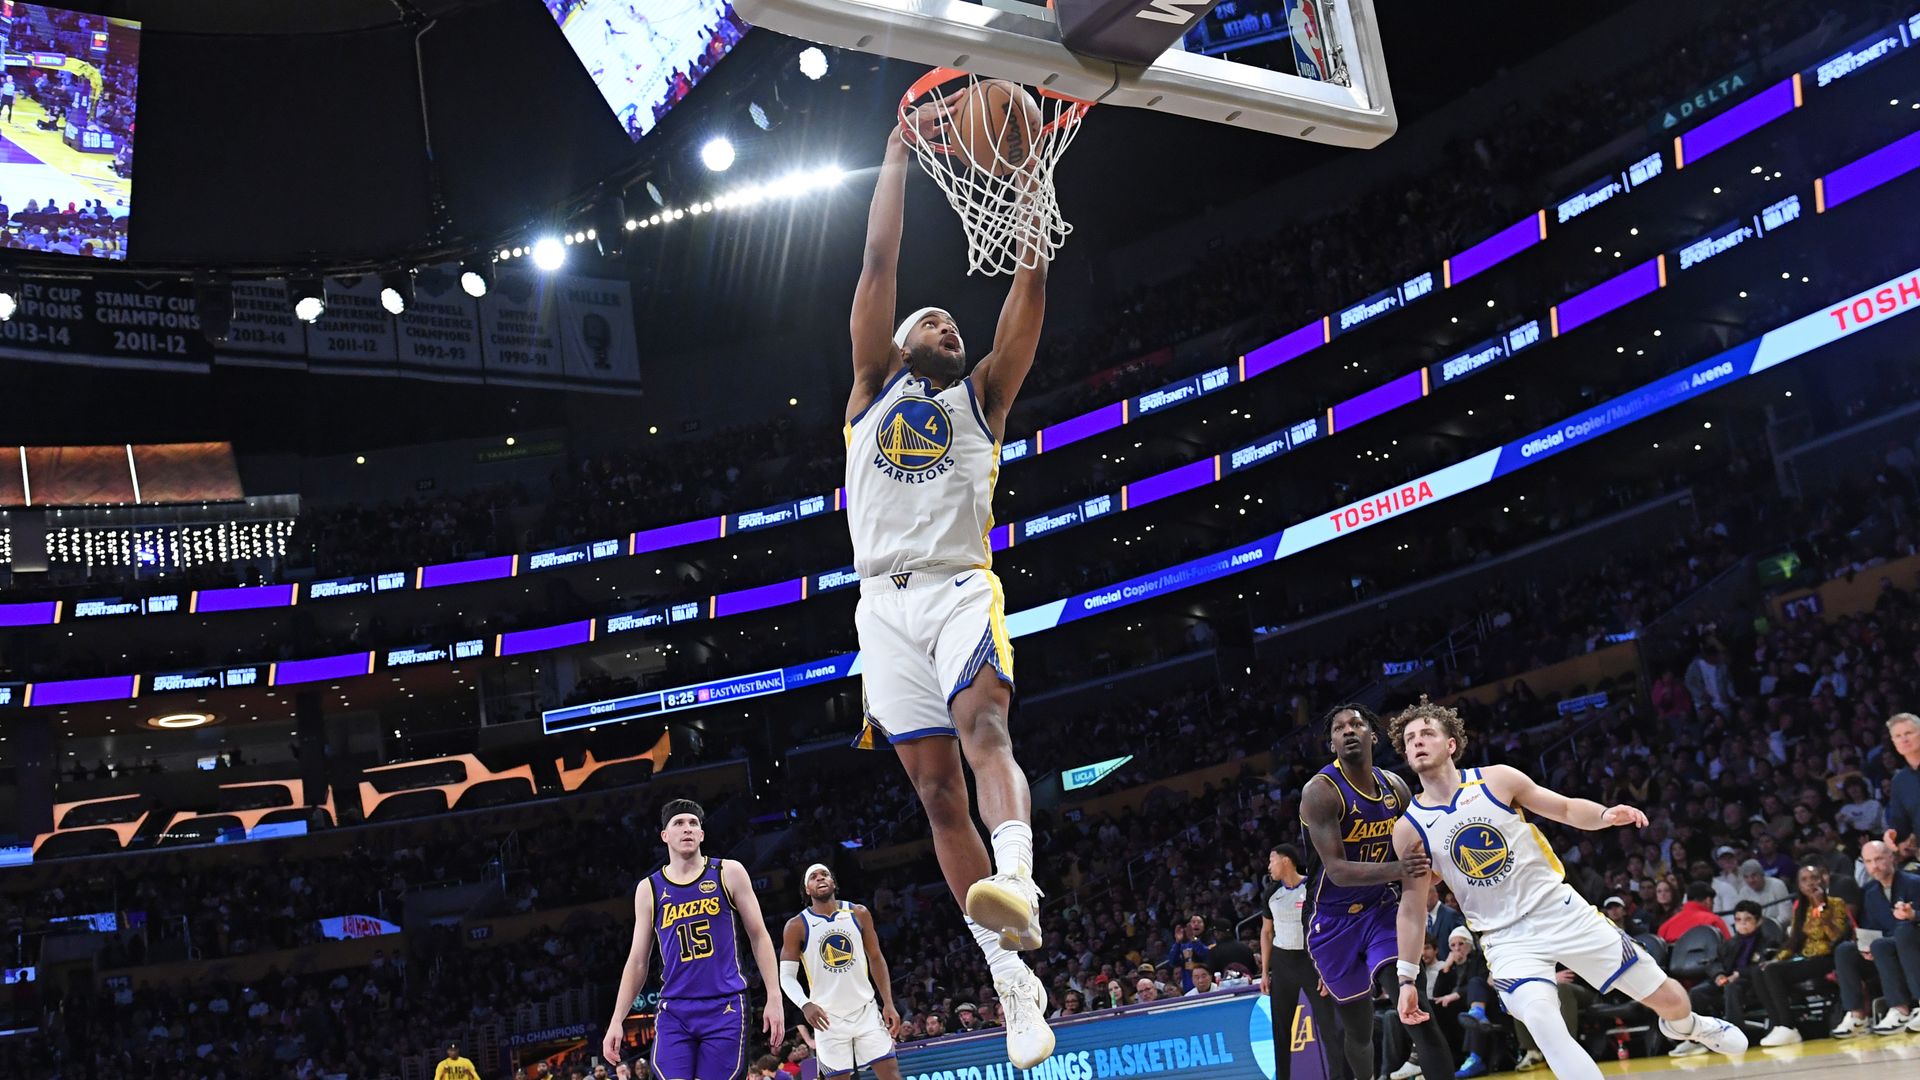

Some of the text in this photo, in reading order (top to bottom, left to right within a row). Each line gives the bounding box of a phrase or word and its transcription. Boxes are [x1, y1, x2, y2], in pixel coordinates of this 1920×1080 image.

[1300, 62, 1317, 78] NBA
[1681, 75, 1745, 117] DELTA
[48, 286, 82, 303] CUP
[95, 291, 165, 309] STANLEY
[22, 300, 84, 321] PIONS
[95, 307, 201, 331] CHAMPIONS
[113, 330, 188, 354] 2011-12
[232, 327, 286, 345] 2013-14
[405, 326, 471, 343] CHAMPIONS
[327, 336, 378, 353] 2011-12
[414, 343, 466, 359] 1992-93
[499, 350, 548, 366] 1990-91
[940, 398, 955, 415] ATE
[1521, 431, 1564, 457] Official
[1691, 361, 1733, 388] Arena
[924, 415, 938, 435] 4
[873, 453, 955, 485] WARRIORS
[1330, 481, 1434, 533] TOSHIBA
[1025, 513, 1077, 536] SPORTSNET+
[530, 551, 585, 569] SPORTSNET+
[818, 572, 860, 590] SPORTSNE
[1084, 590, 1121, 610] Official
[1231, 548, 1263, 567] Arena
[672, 606, 698, 622] NBA APP
[607, 615, 663, 633] SPORTSNET+
[805, 664, 836, 680] Arena
[667, 691, 695, 706] 8:25
[1074, 771, 1095, 783] UCLA
[1443, 816, 1493, 851] GOLDEN STATE
[1480, 831, 1494, 847] 2
[1360, 841, 1389, 864] 17
[1466, 849, 1516, 888] WARRIORS
[661, 896, 720, 930] LAKERS
[676, 919, 715, 963] 15
[840, 939, 846, 950] 7
[822, 958, 857, 974] WARRIORS
[526, 1024, 585, 1043] CHAMPIONS
[1290, 1004, 1316, 1052] LA
[1096, 1031, 1234, 1080] BASKETBALL
